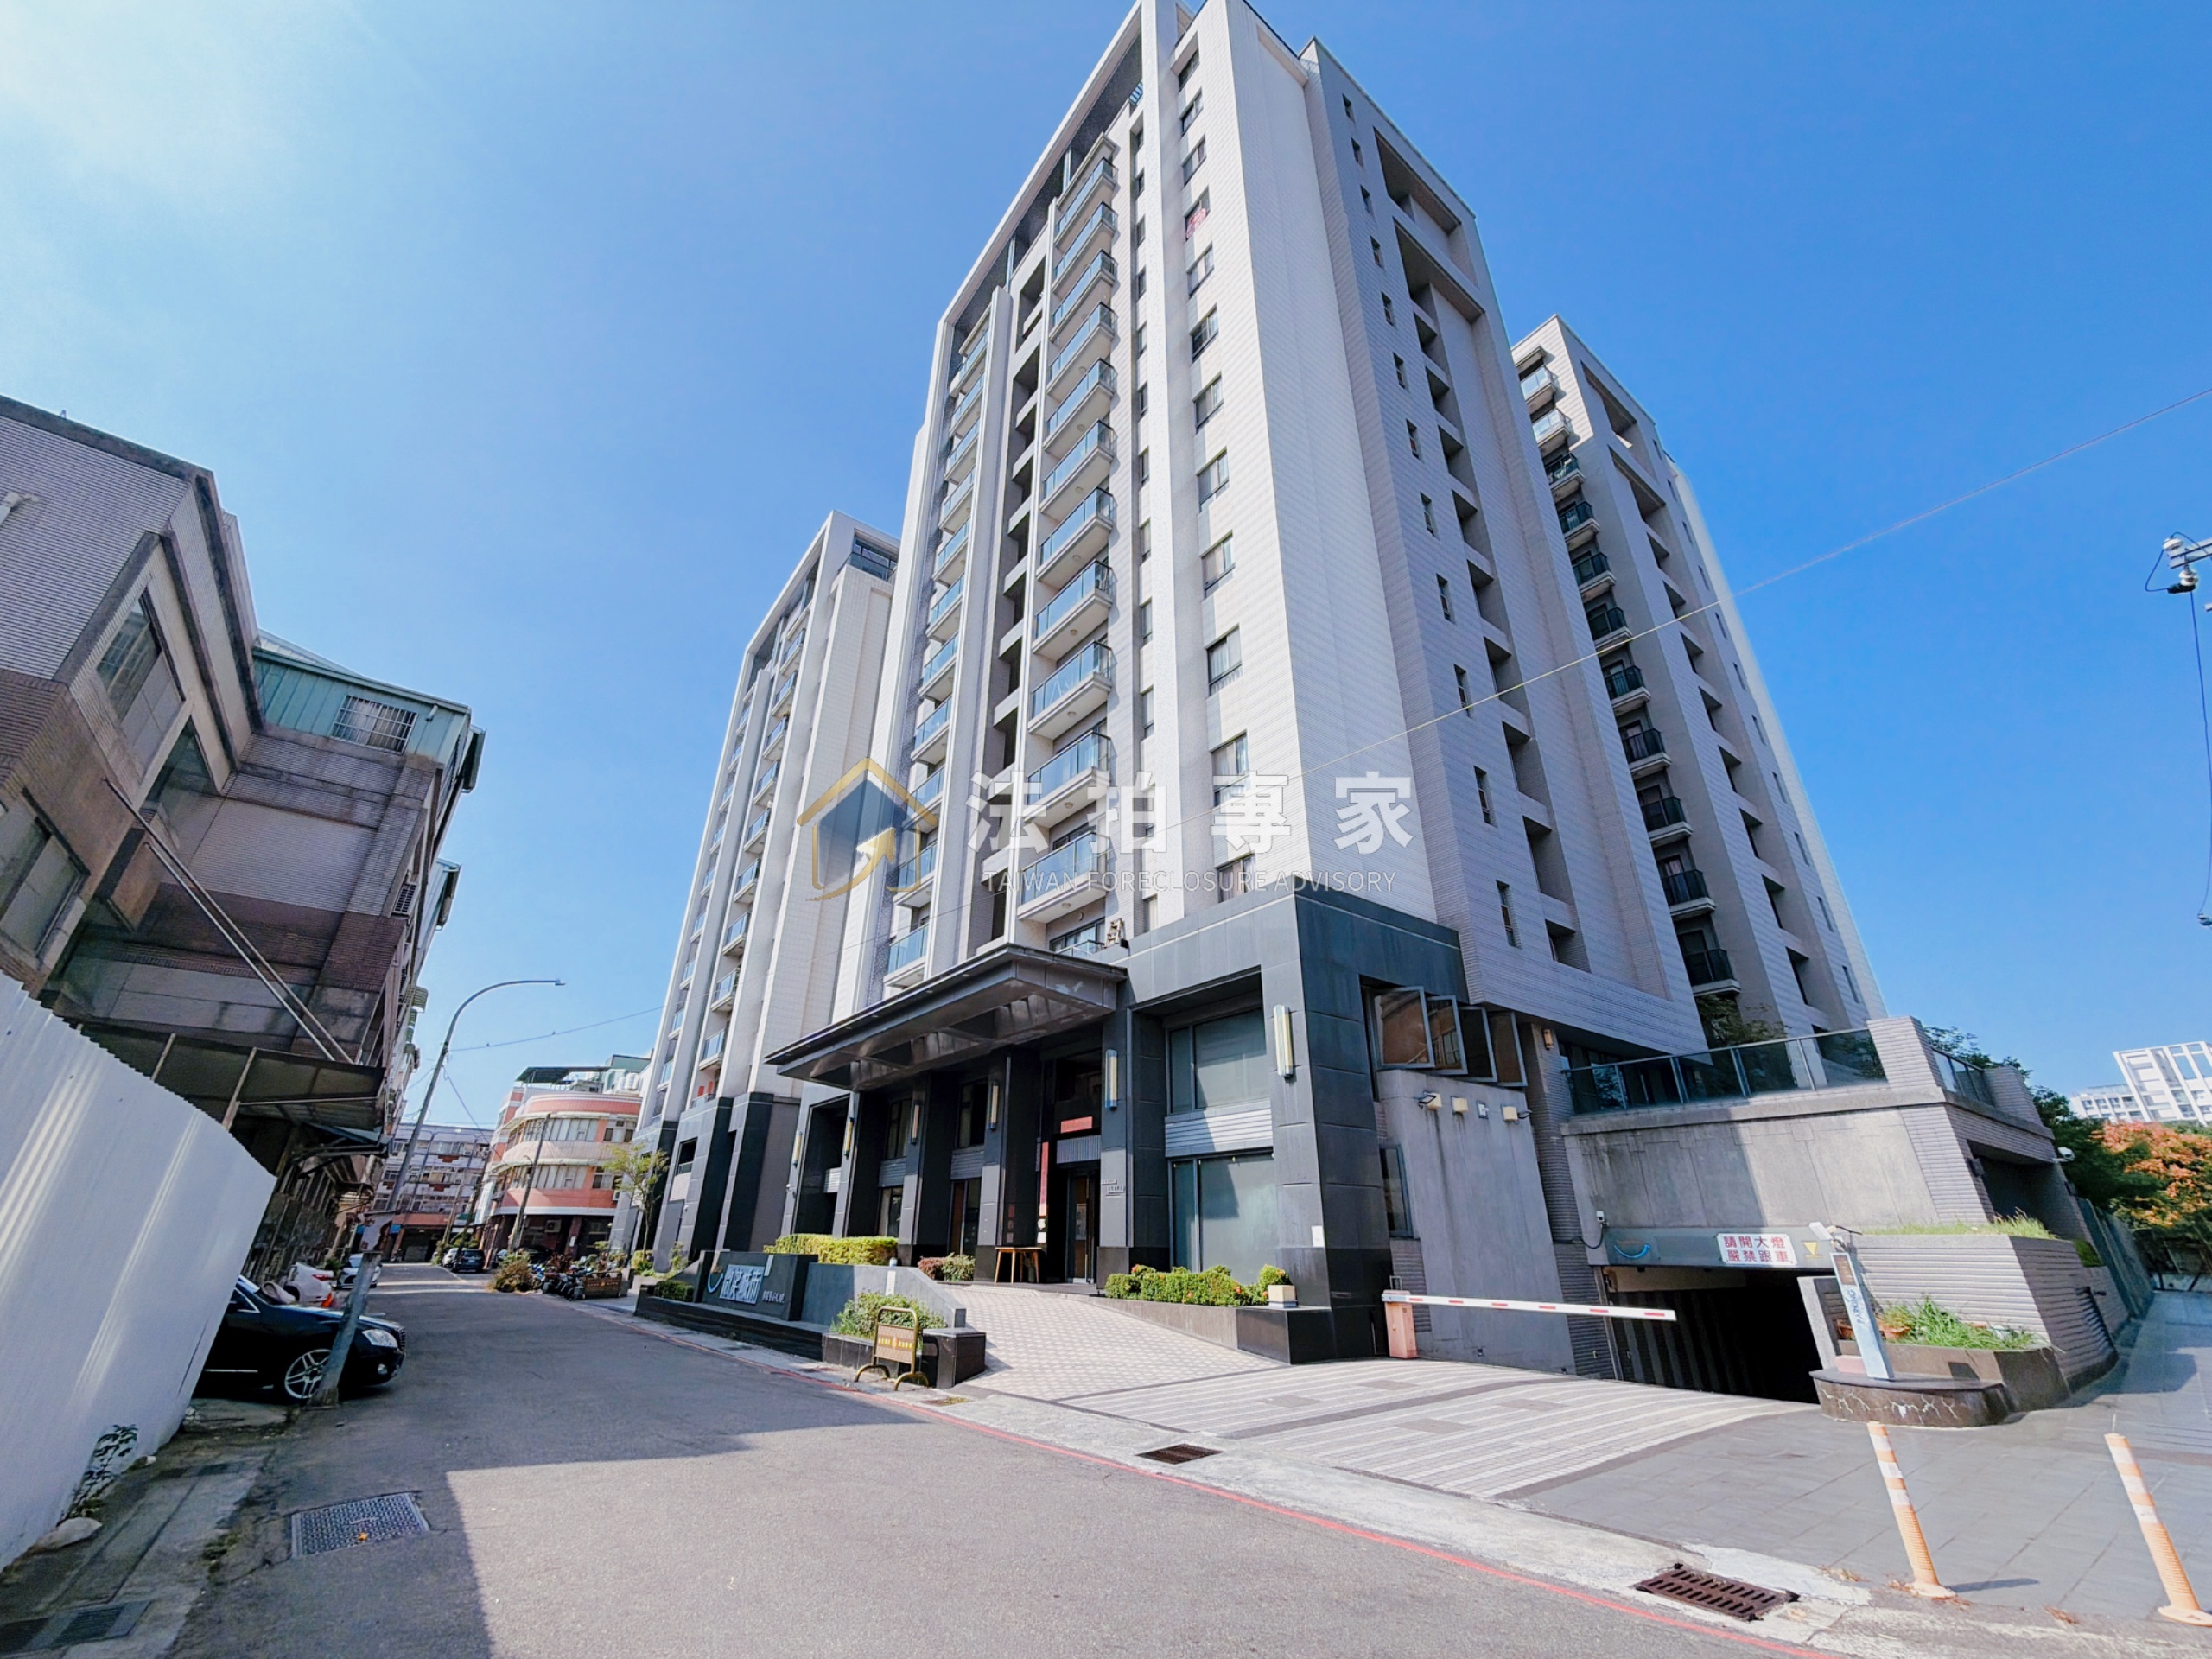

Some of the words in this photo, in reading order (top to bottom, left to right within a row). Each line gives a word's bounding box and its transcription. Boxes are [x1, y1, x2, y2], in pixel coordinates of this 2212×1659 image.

[1724, 1236, 1786, 1249] 請開大燈
[1726, 1249, 1789, 1262] 嚴禁跟車
